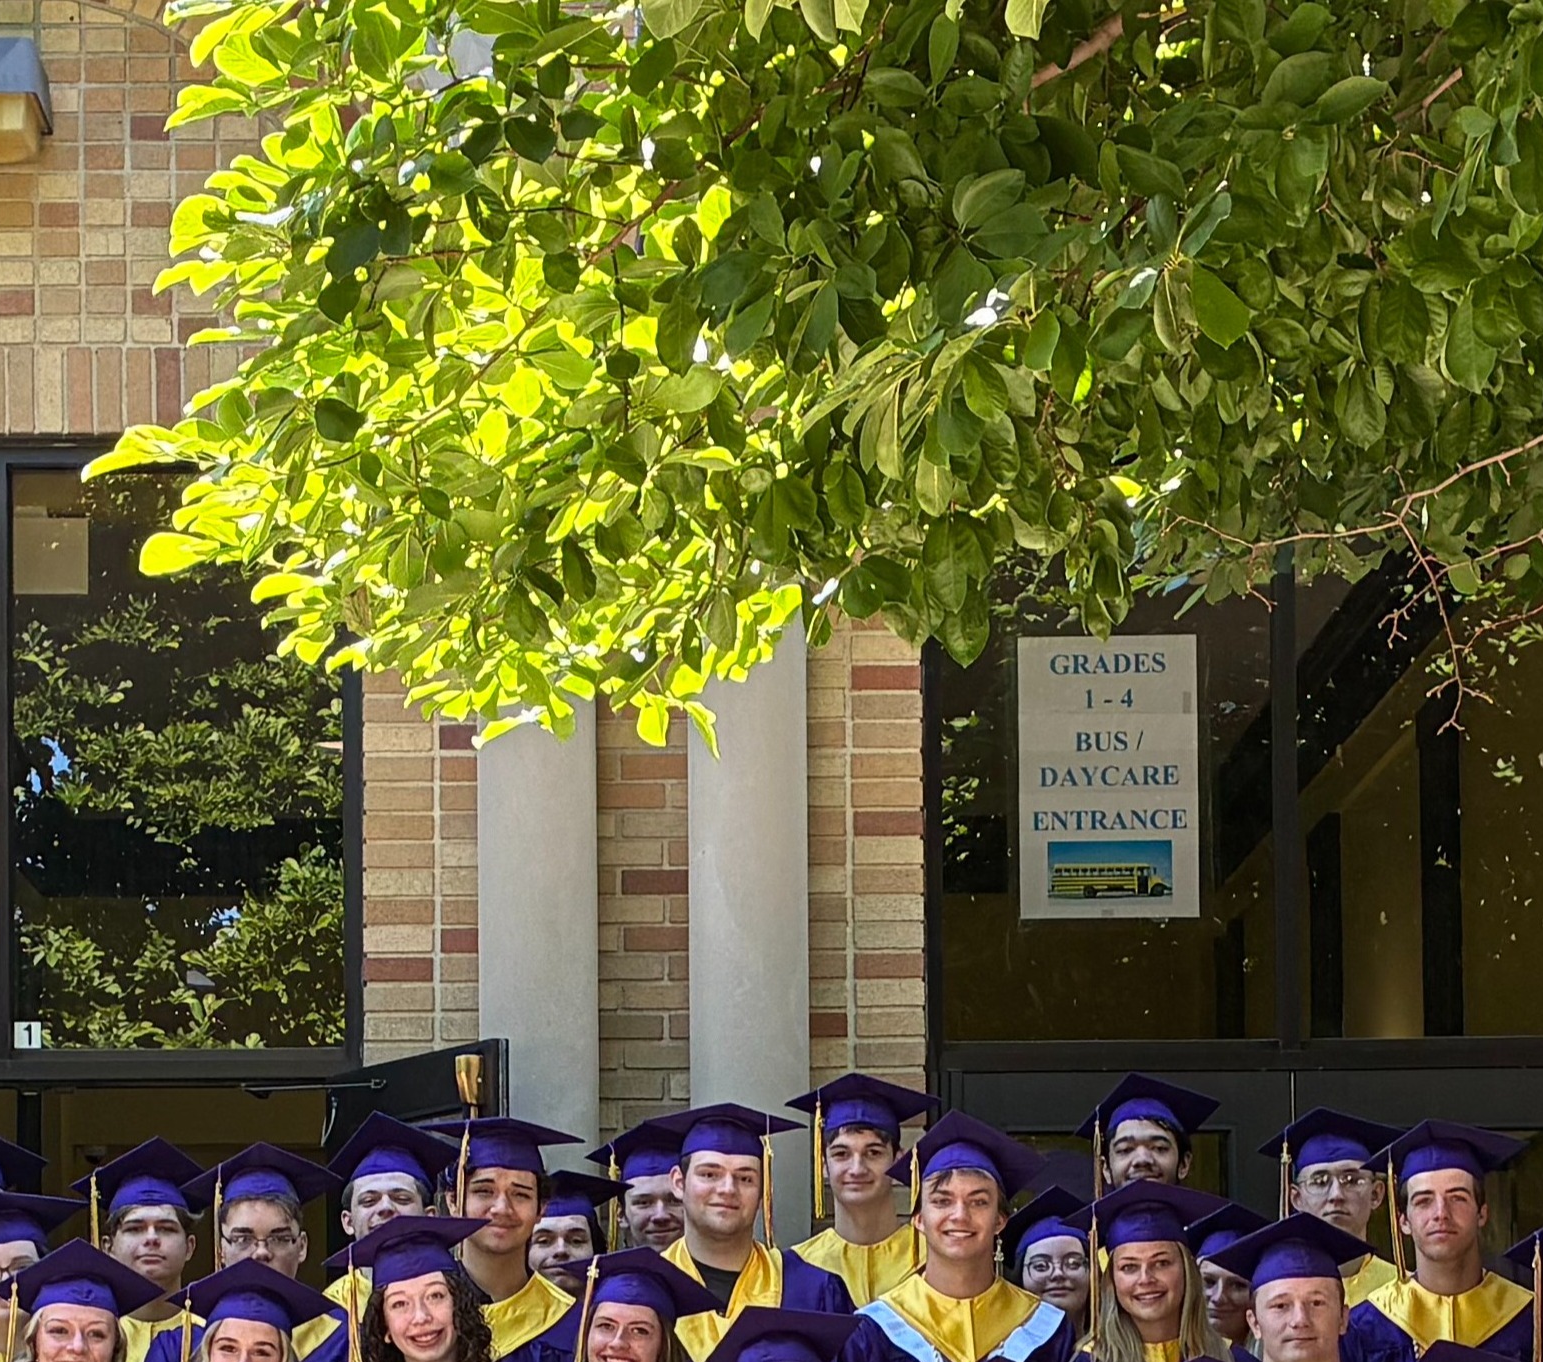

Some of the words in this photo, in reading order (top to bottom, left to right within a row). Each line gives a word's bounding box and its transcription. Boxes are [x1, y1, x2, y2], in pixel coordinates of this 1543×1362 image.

[1049, 652, 1167, 675] GRADES
[1085, 689, 1094, 709] 1
[1120, 688, 1134, 708] 4
[1075, 731, 1129, 752] BUS
[1039, 765, 1180, 788] DAYCARE
[1033, 809, 1188, 832] ENTRANCE
[23, 1023, 33, 1047] 1
